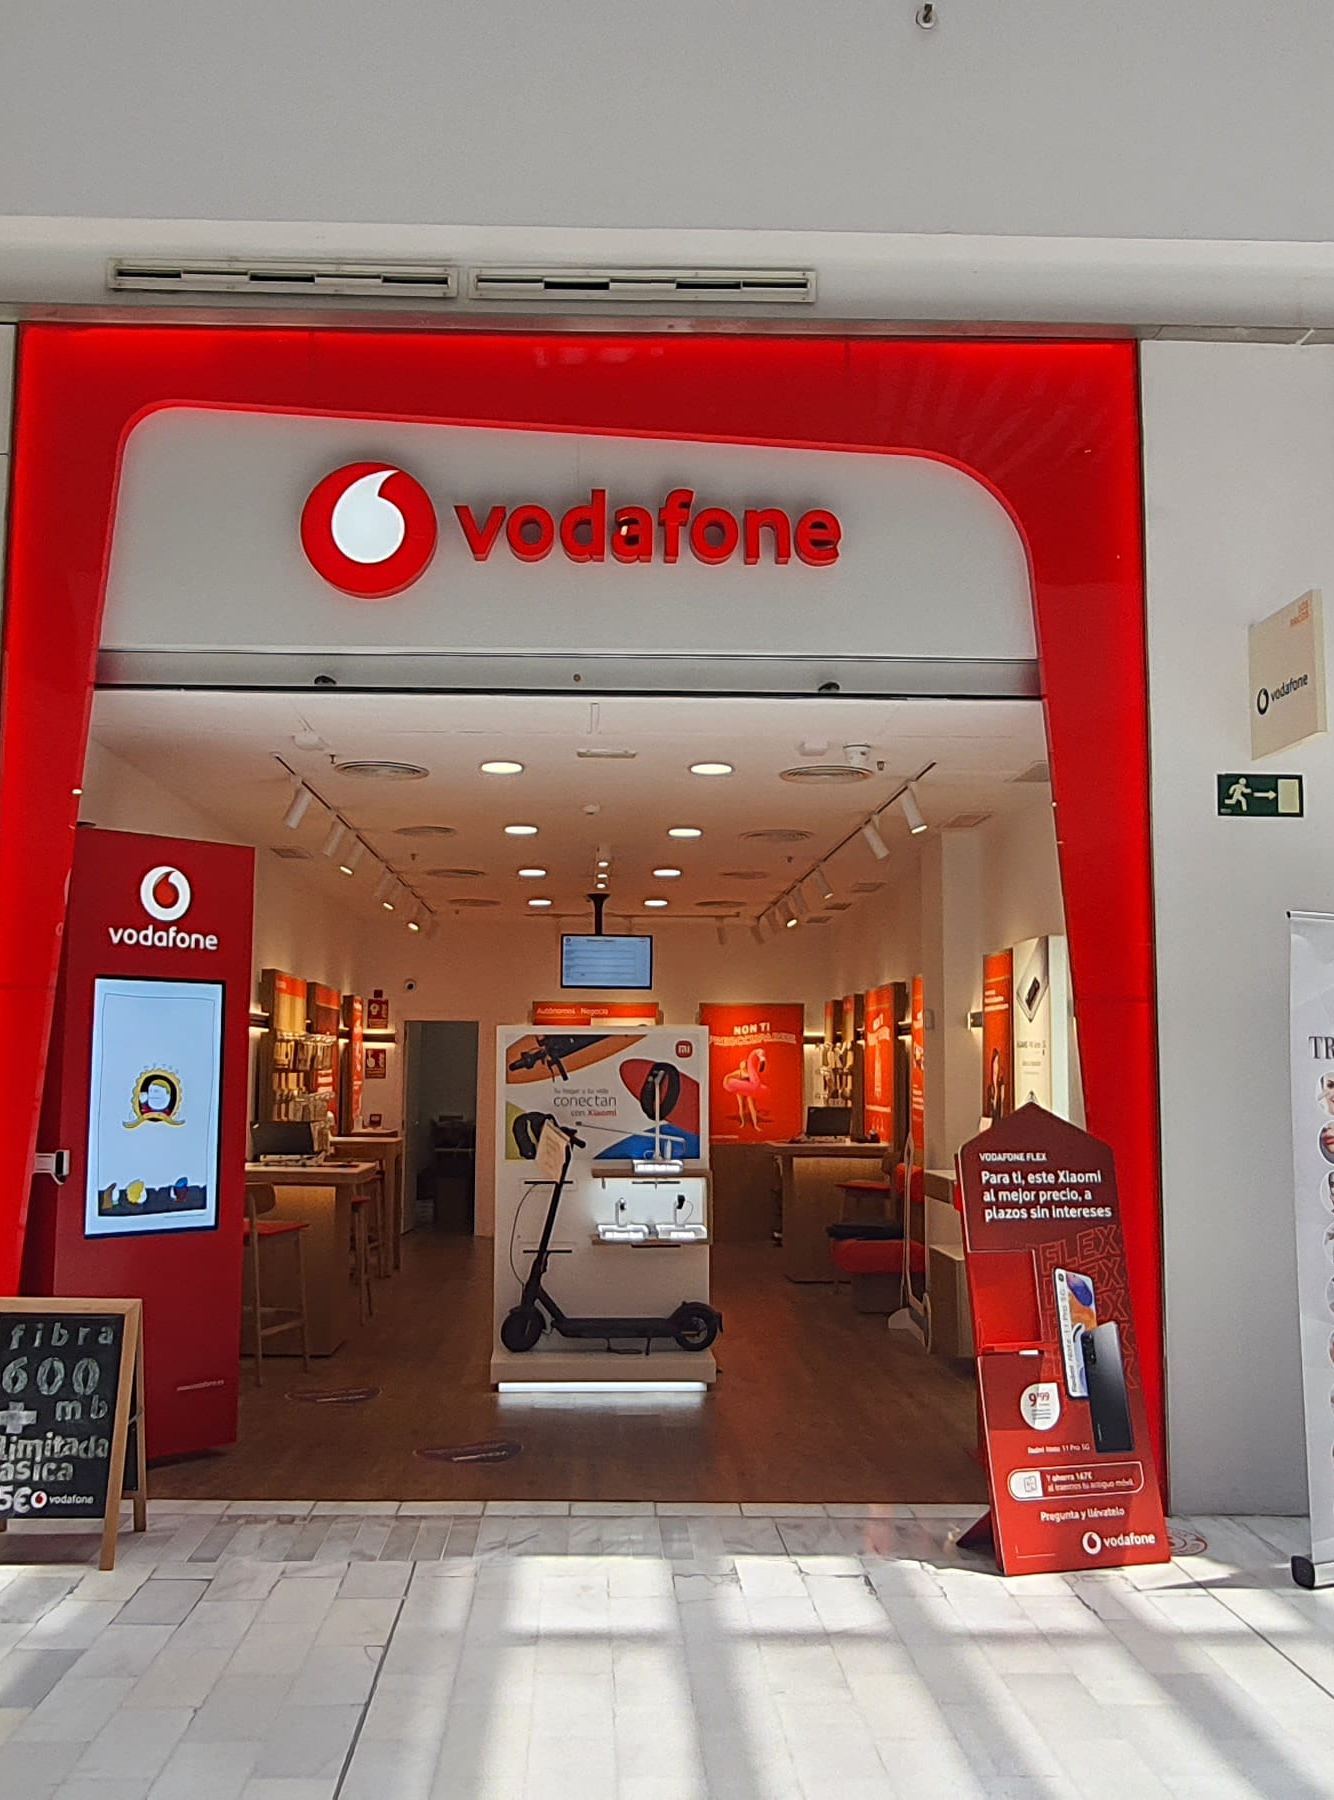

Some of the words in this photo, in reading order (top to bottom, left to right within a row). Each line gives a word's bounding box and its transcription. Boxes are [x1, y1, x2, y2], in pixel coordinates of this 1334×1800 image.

[454, 488, 843, 567] vodafone
[1270, 673, 1309, 702] vodafone
[108, 924, 219, 951] vodafone
[553, 1094, 617, 1107] conectan
[979, 1152, 1026, 1161] VODAFONE
[1026, 1152, 1047, 1161] FLEX
[981, 1171, 1010, 1185] Para
[1012, 1171, 1026, 1185] ti,
[1027, 1172, 1055, 1184] este
[1057, 1170, 1102, 1184] Xiaomi
[983, 1188, 995, 1202] al
[998, 1188, 1037, 1204] mejor
[1038, 1187, 1082, 1204] precio,
[1084, 1189, 1092, 1201] a
[984, 1206, 1028, 1222] plazos
[1030, 1205, 1049, 1219] sin
[1052, 1205, 1113, 1219] intereses
[9, 1322, 115, 1350] fibra
[1, 1355, 101, 1396] 600
[49, 1494, 95, 1505] vodafone
[1040, 1510, 1080, 1523] Pregunta
[1080, 1511, 1086, 1520] y
[1103, 1532, 1155, 1547] vodafone
